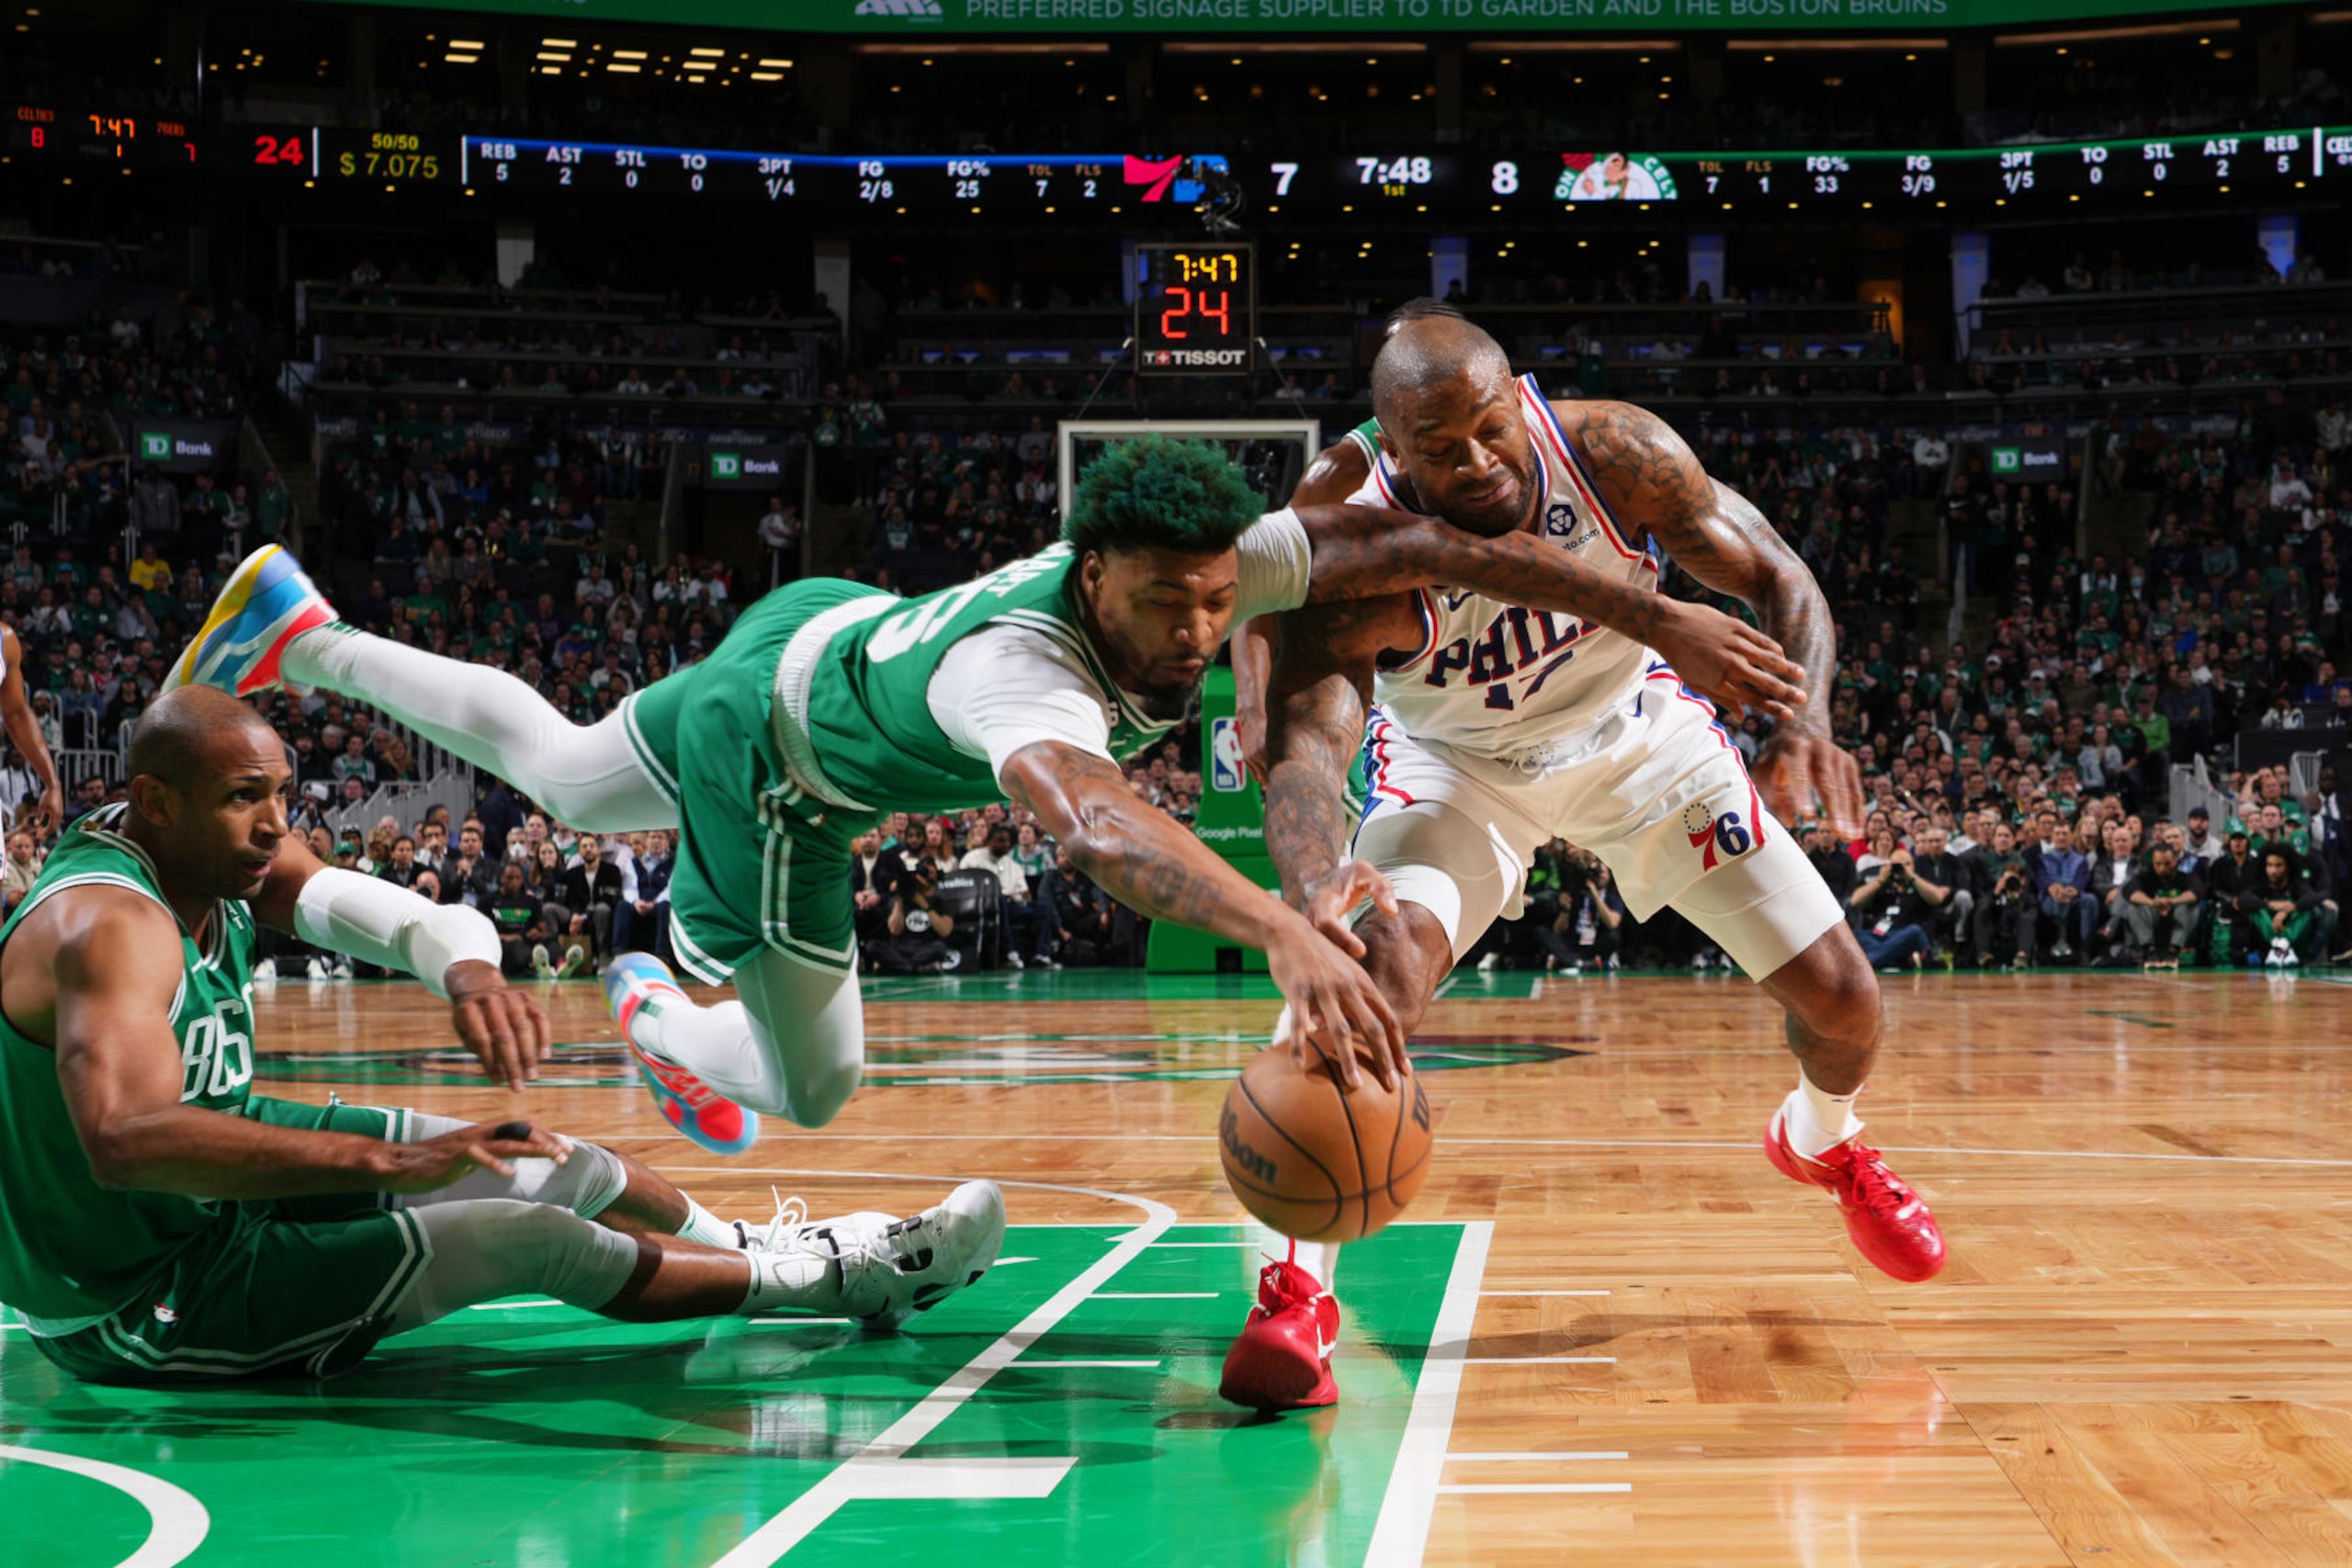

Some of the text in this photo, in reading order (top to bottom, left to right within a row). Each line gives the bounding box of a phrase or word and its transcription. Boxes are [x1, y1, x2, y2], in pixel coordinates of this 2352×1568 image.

[967, 0, 1948, 18] PREFERRED SIGNAGE SUPPLIER TO TD GARDEN AND THE BOSTON BRUINS
[17, 106, 55, 122] CELTICS
[89, 114, 135, 139] 7:47
[156, 120, 185, 137] 76ERS
[31, 126, 45, 148] 8
[371, 132, 419, 151] 50/50
[2264, 135, 2299, 152] REB
[184, 142, 196, 162] 7
[254, 135, 304, 165] 24
[481, 143, 516, 160] REB
[547, 146, 582, 164] AST
[2081, 147, 2108, 164] TO
[2143, 143, 2175, 160] STL
[2203, 139, 2239, 156] AST
[339, 152, 356, 176] $
[616, 151, 646, 167] STL
[681, 153, 707, 171] TO
[759, 158, 791, 175] 3PT
[1698, 161, 1724, 173] TOL
[1746, 160, 1772, 173] FLS
[1806, 156, 1849, 172] FG%
[1906, 155, 1932, 171] FG
[2000, 152, 2034, 168] 3PT
[2216, 159, 2229, 177] 2
[2277, 154, 2290, 174] 5
[495, 163, 508, 182] 5
[560, 166, 571, 186] 2
[626, 170, 639, 188] 0
[859, 162, 885, 178] FG
[946, 162, 991, 178] FG%
[1028, 164, 1053, 176] TOL
[1076, 164, 1101, 176] FLS
[1356, 157, 1432, 185] 7:48
[1491, 161, 1519, 195] 8
[2089, 166, 2103, 185] 0
[2154, 163, 2166, 181] 0
[691, 174, 704, 192] 0
[765, 177, 796, 199] 1/4
[956, 180, 979, 198] 25
[1035, 179, 1048, 197] 7
[1083, 179, 1096, 198] 2
[1271, 163, 1298, 197] 7
[1706, 176, 1719, 194] 7
[1758, 176, 1770, 194] 1
[1815, 175, 1838, 194] 33
[1902, 175, 1936, 197] 3/9
[2002, 170, 2034, 195] 1/5
[860, 180, 894, 203] 2/8
[1382, 184, 1407, 197] 1st
[1173, 254, 1238, 282] 7:47
[1160, 287, 1229, 339] 24
[1170, 351, 1246, 365] TISSOT
[143, 437, 212, 456] TD Bank
[714, 456, 738, 474] TD
[744, 459, 780, 474] Bank
[1995, 452, 2018, 468] TD
[2023, 451, 2059, 466] Bank
[1196, 827, 1236, 840] Google
[1687, 811, 1751, 873] 76
